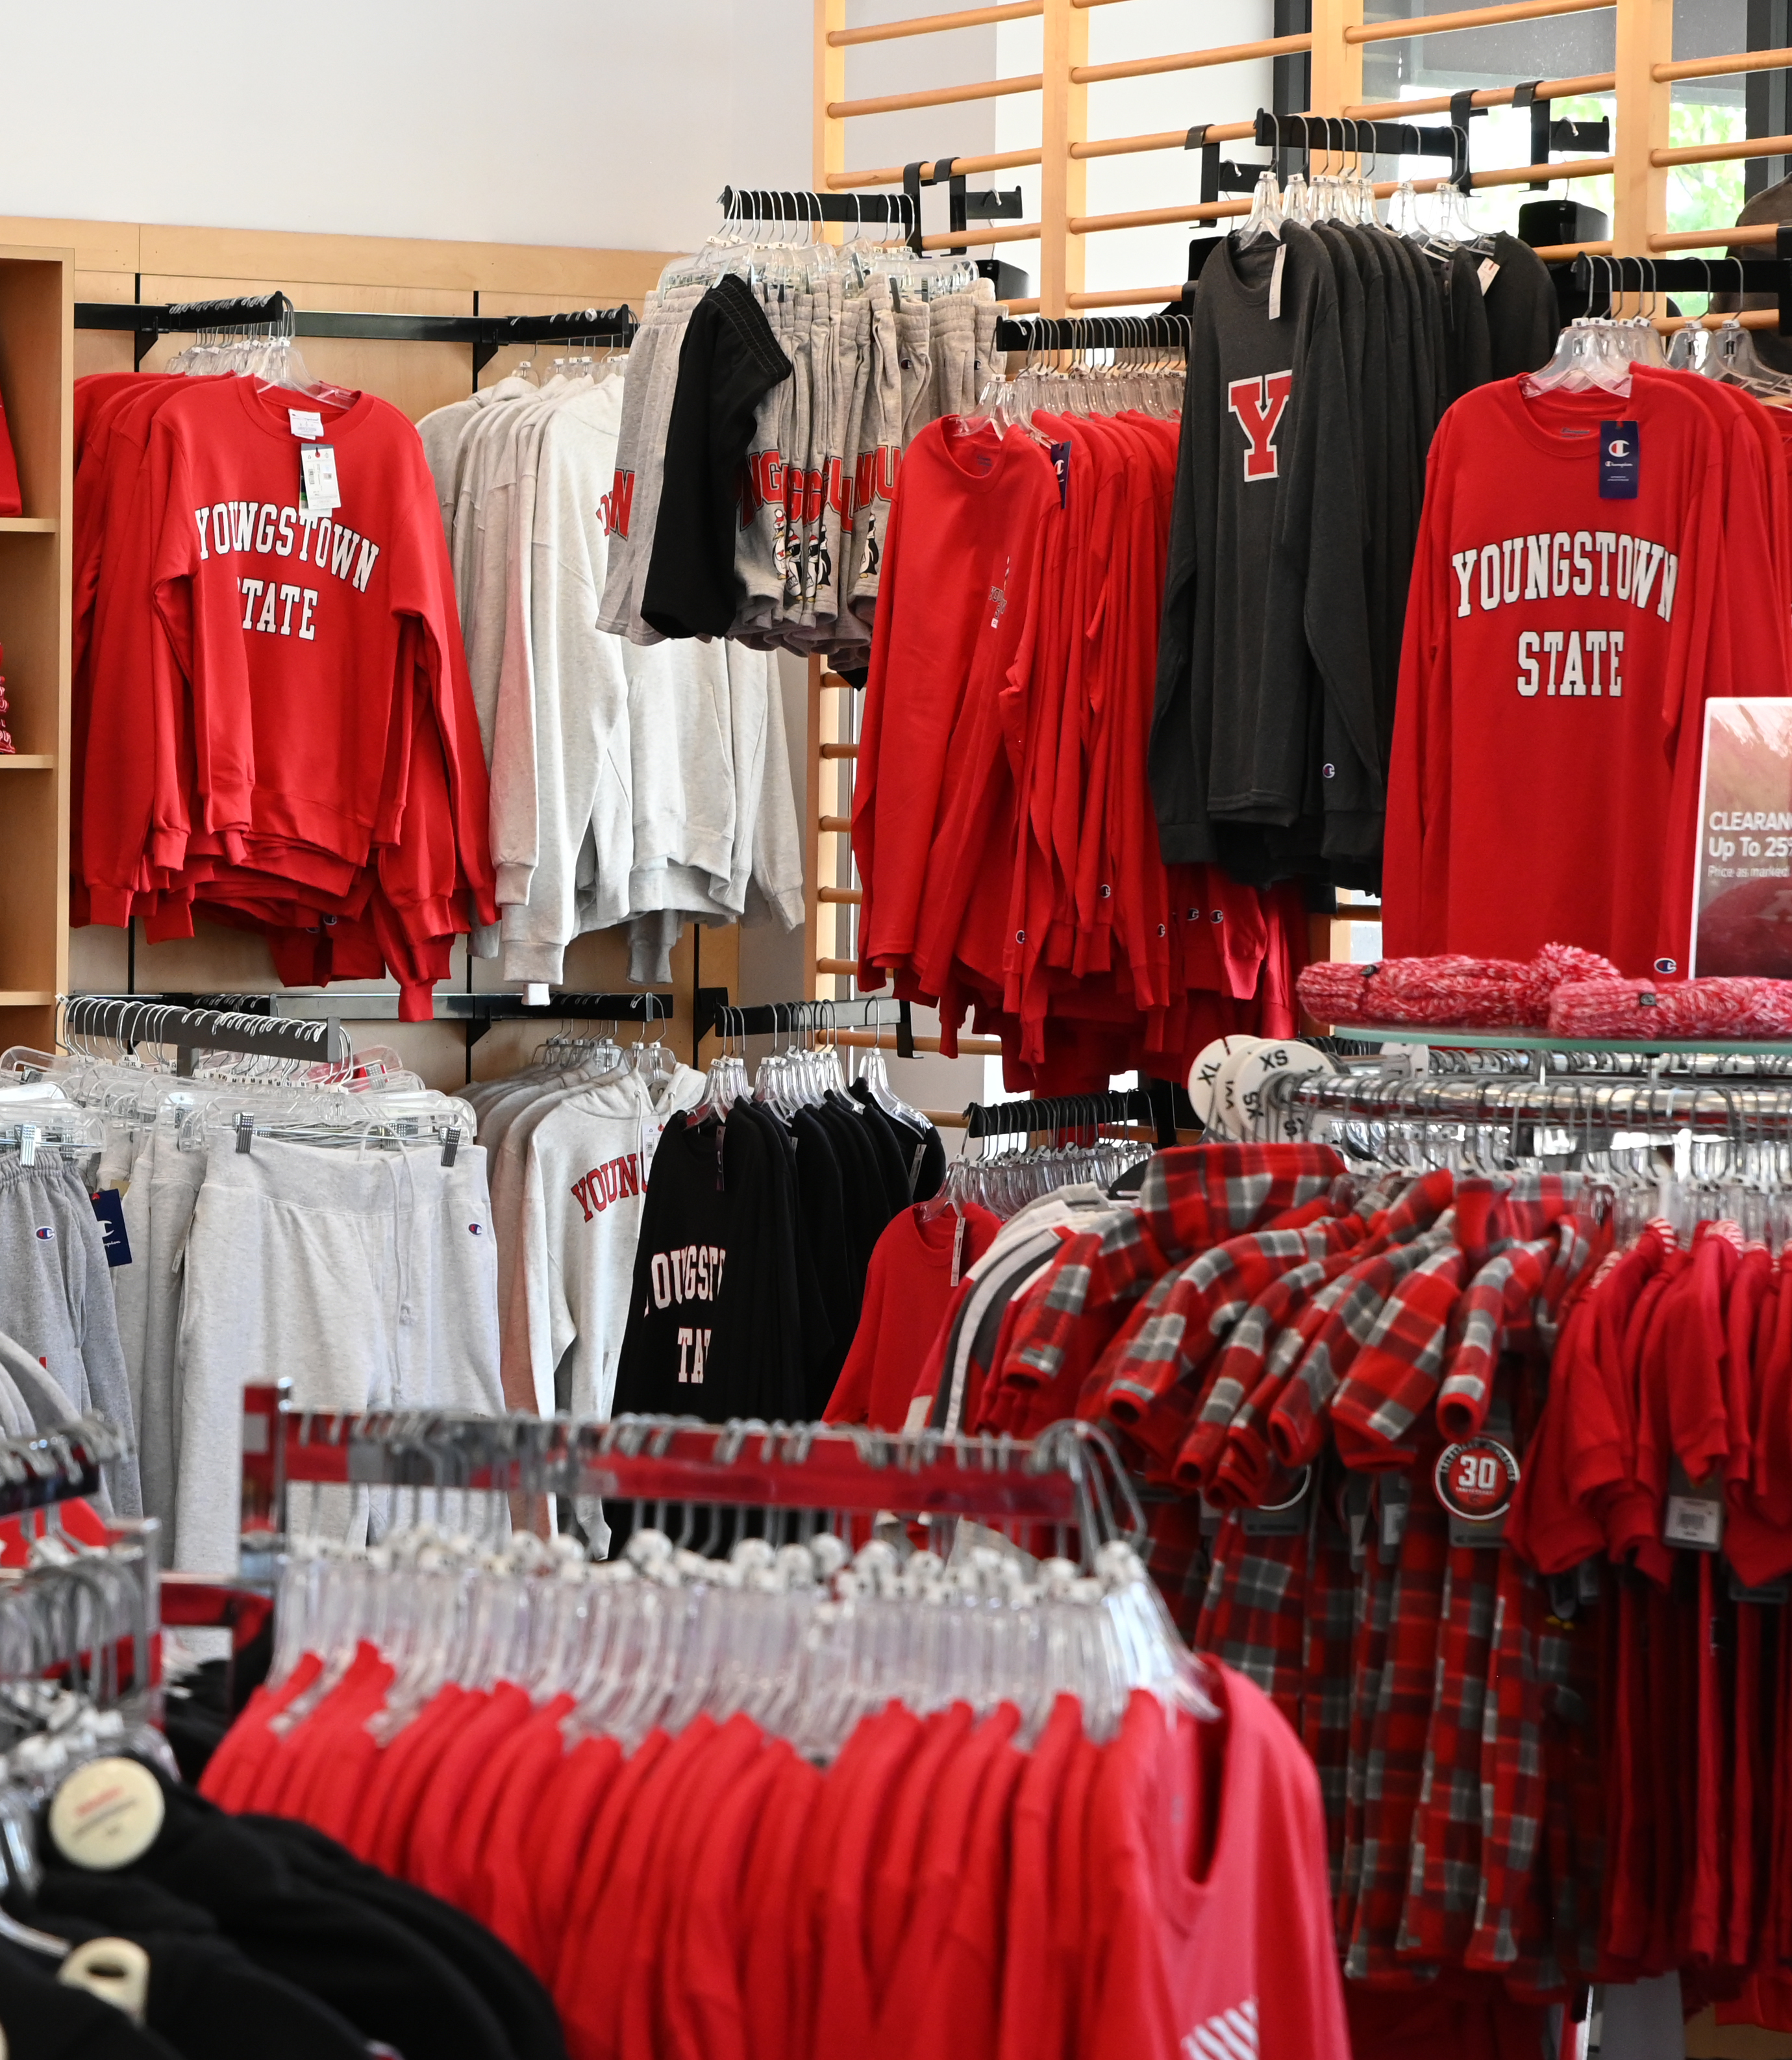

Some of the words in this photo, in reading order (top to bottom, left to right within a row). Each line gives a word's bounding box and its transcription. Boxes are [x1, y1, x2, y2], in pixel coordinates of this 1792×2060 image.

[1228, 370, 1293, 482] Y
[1452, 531, 1678, 623] YOUNGSTOWN
[236, 576, 319, 641] TATE
[1517, 631, 1624, 697] STATE
[1708, 836, 1736, 862] Up
[1739, 836, 1761, 857] To
[1708, 865, 1734, 877] Price
[1736, 868, 1748, 877] as
[1750, 866, 1790, 877] marked
[1197, 1062, 1221, 1086] XL
[1259, 1049, 1288, 1071] XS
[1458, 1455, 1498, 1489] 30
